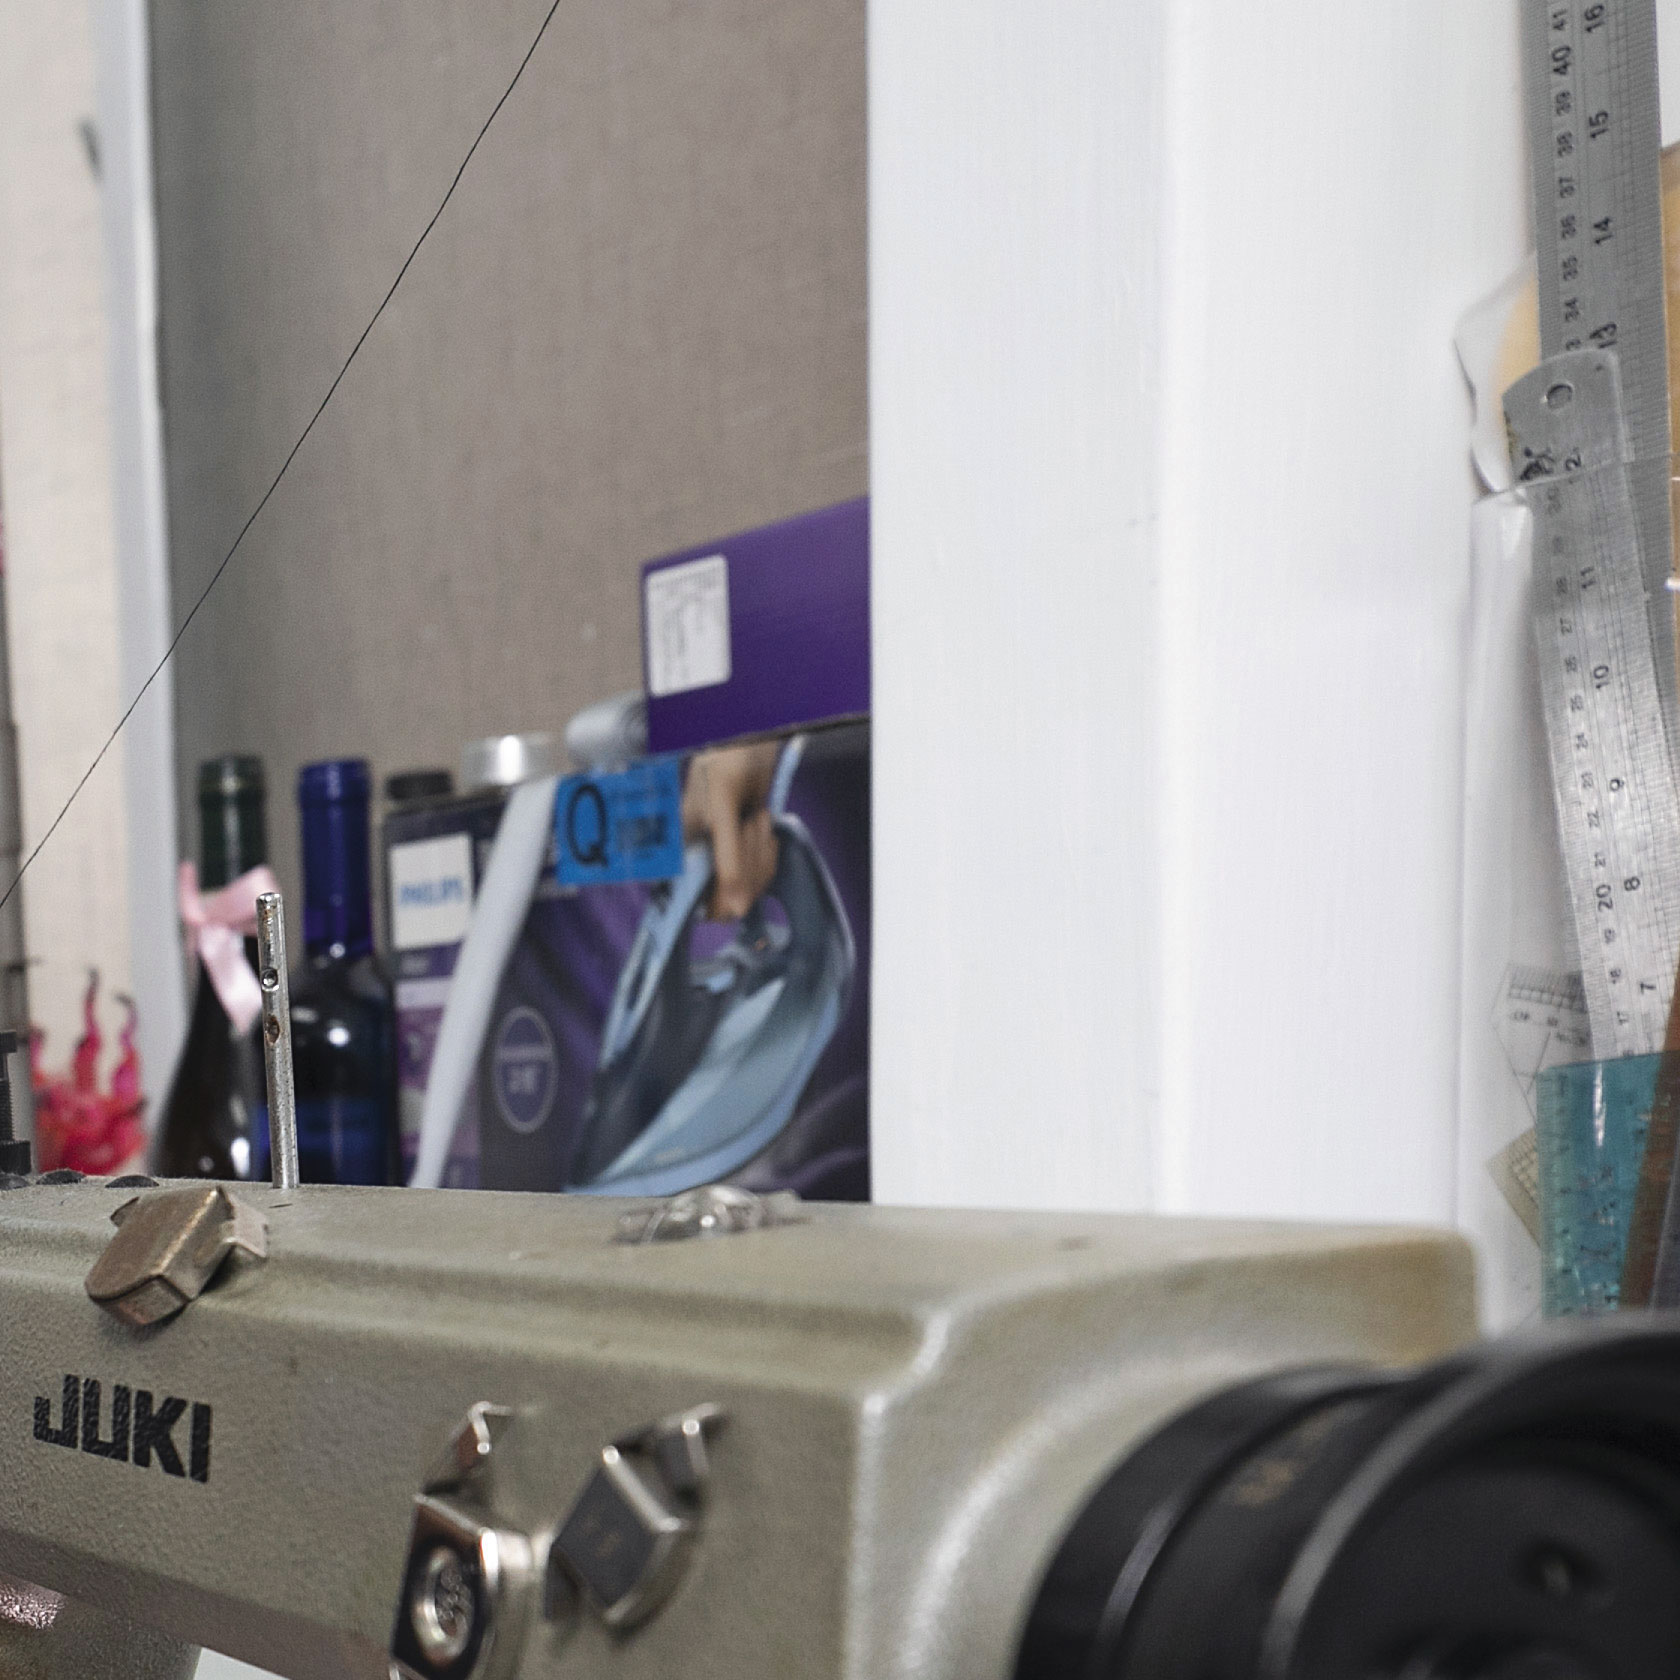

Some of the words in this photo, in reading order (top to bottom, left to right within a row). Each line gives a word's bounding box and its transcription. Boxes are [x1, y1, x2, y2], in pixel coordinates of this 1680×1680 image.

[1552, 8, 1567, 31] 41
[1584, 4, 1605, 33] 16
[1551, 45, 1571, 75] 40
[1589, 110, 1609, 139] 15
[1558, 175, 1575, 198] 37
[1593, 216, 1614, 245] 14
[1564, 296, 1580, 322] 34
[1580, 566, 1597, 589] 11
[1593, 665, 1610, 690] 10
[1609, 778, 1625, 792] 9
[1624, 876, 1641, 892] 8
[1640, 980, 1657, 995] 7
[567, 782, 608, 868] Q
[1596, 884, 1613, 912] 20
[33, 1374, 212, 1484] JUKI
